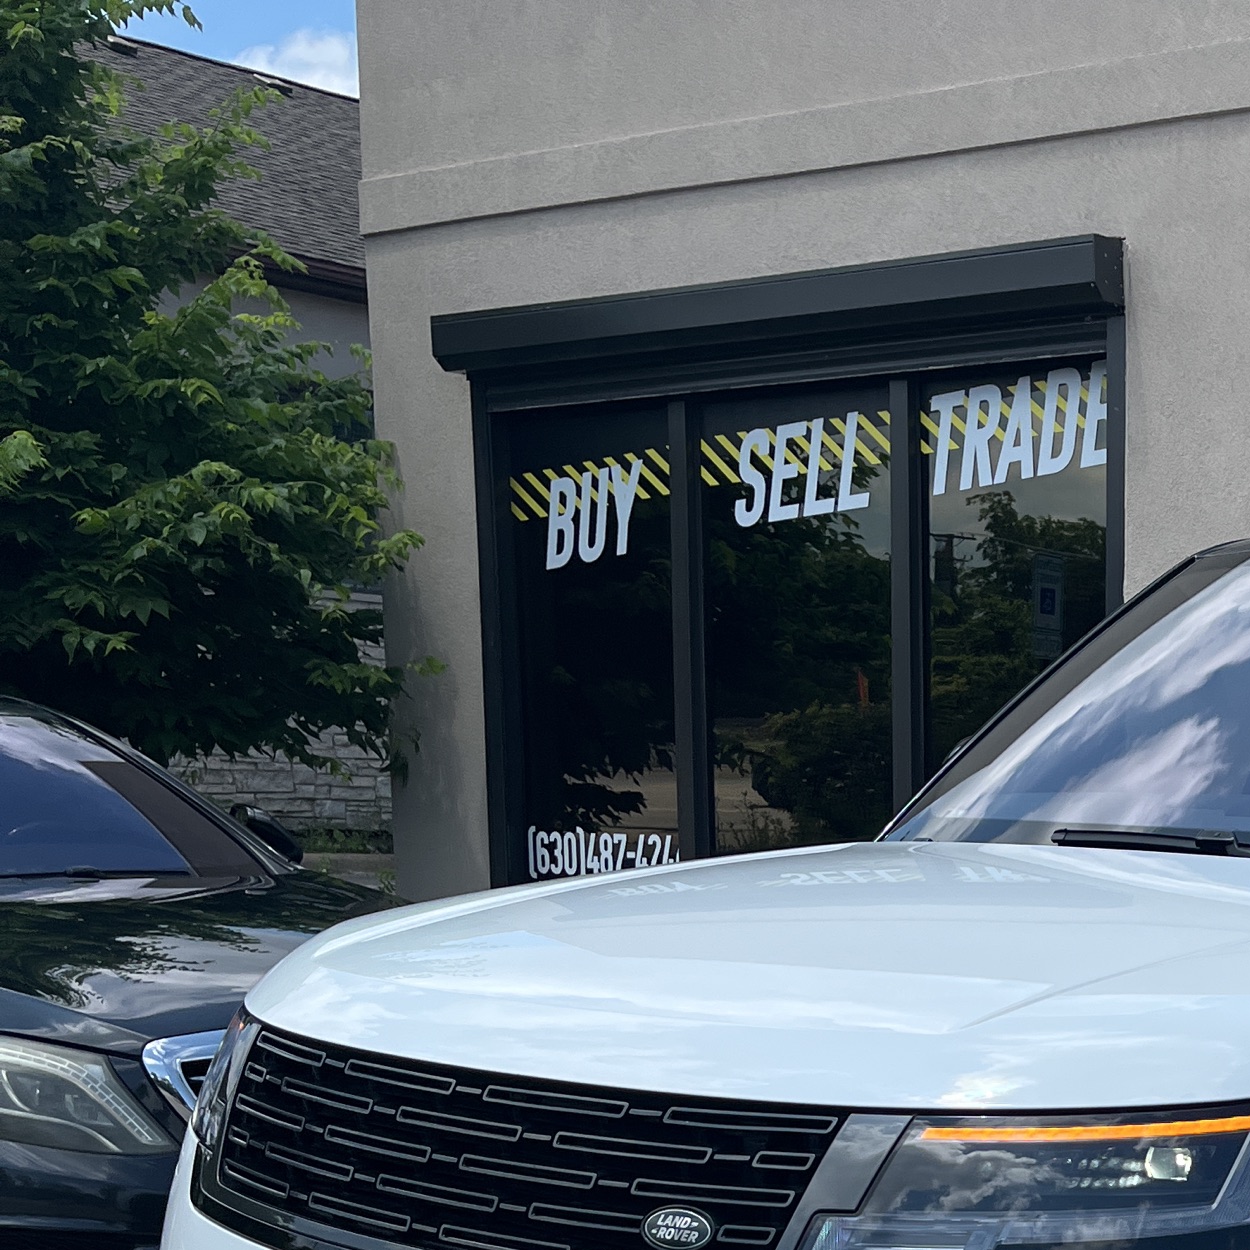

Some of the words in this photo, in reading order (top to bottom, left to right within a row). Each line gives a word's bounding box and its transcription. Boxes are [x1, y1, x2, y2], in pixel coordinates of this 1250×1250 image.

[546, 458, 643, 571] BUY
[733, 411, 871, 528] SELL
[929, 359, 1107, 496] TRADE
[528, 825, 680, 879] (630)487-424
[656, 1213, 692, 1229] LAND
[656, 1226, 699, 1243] ROVER
